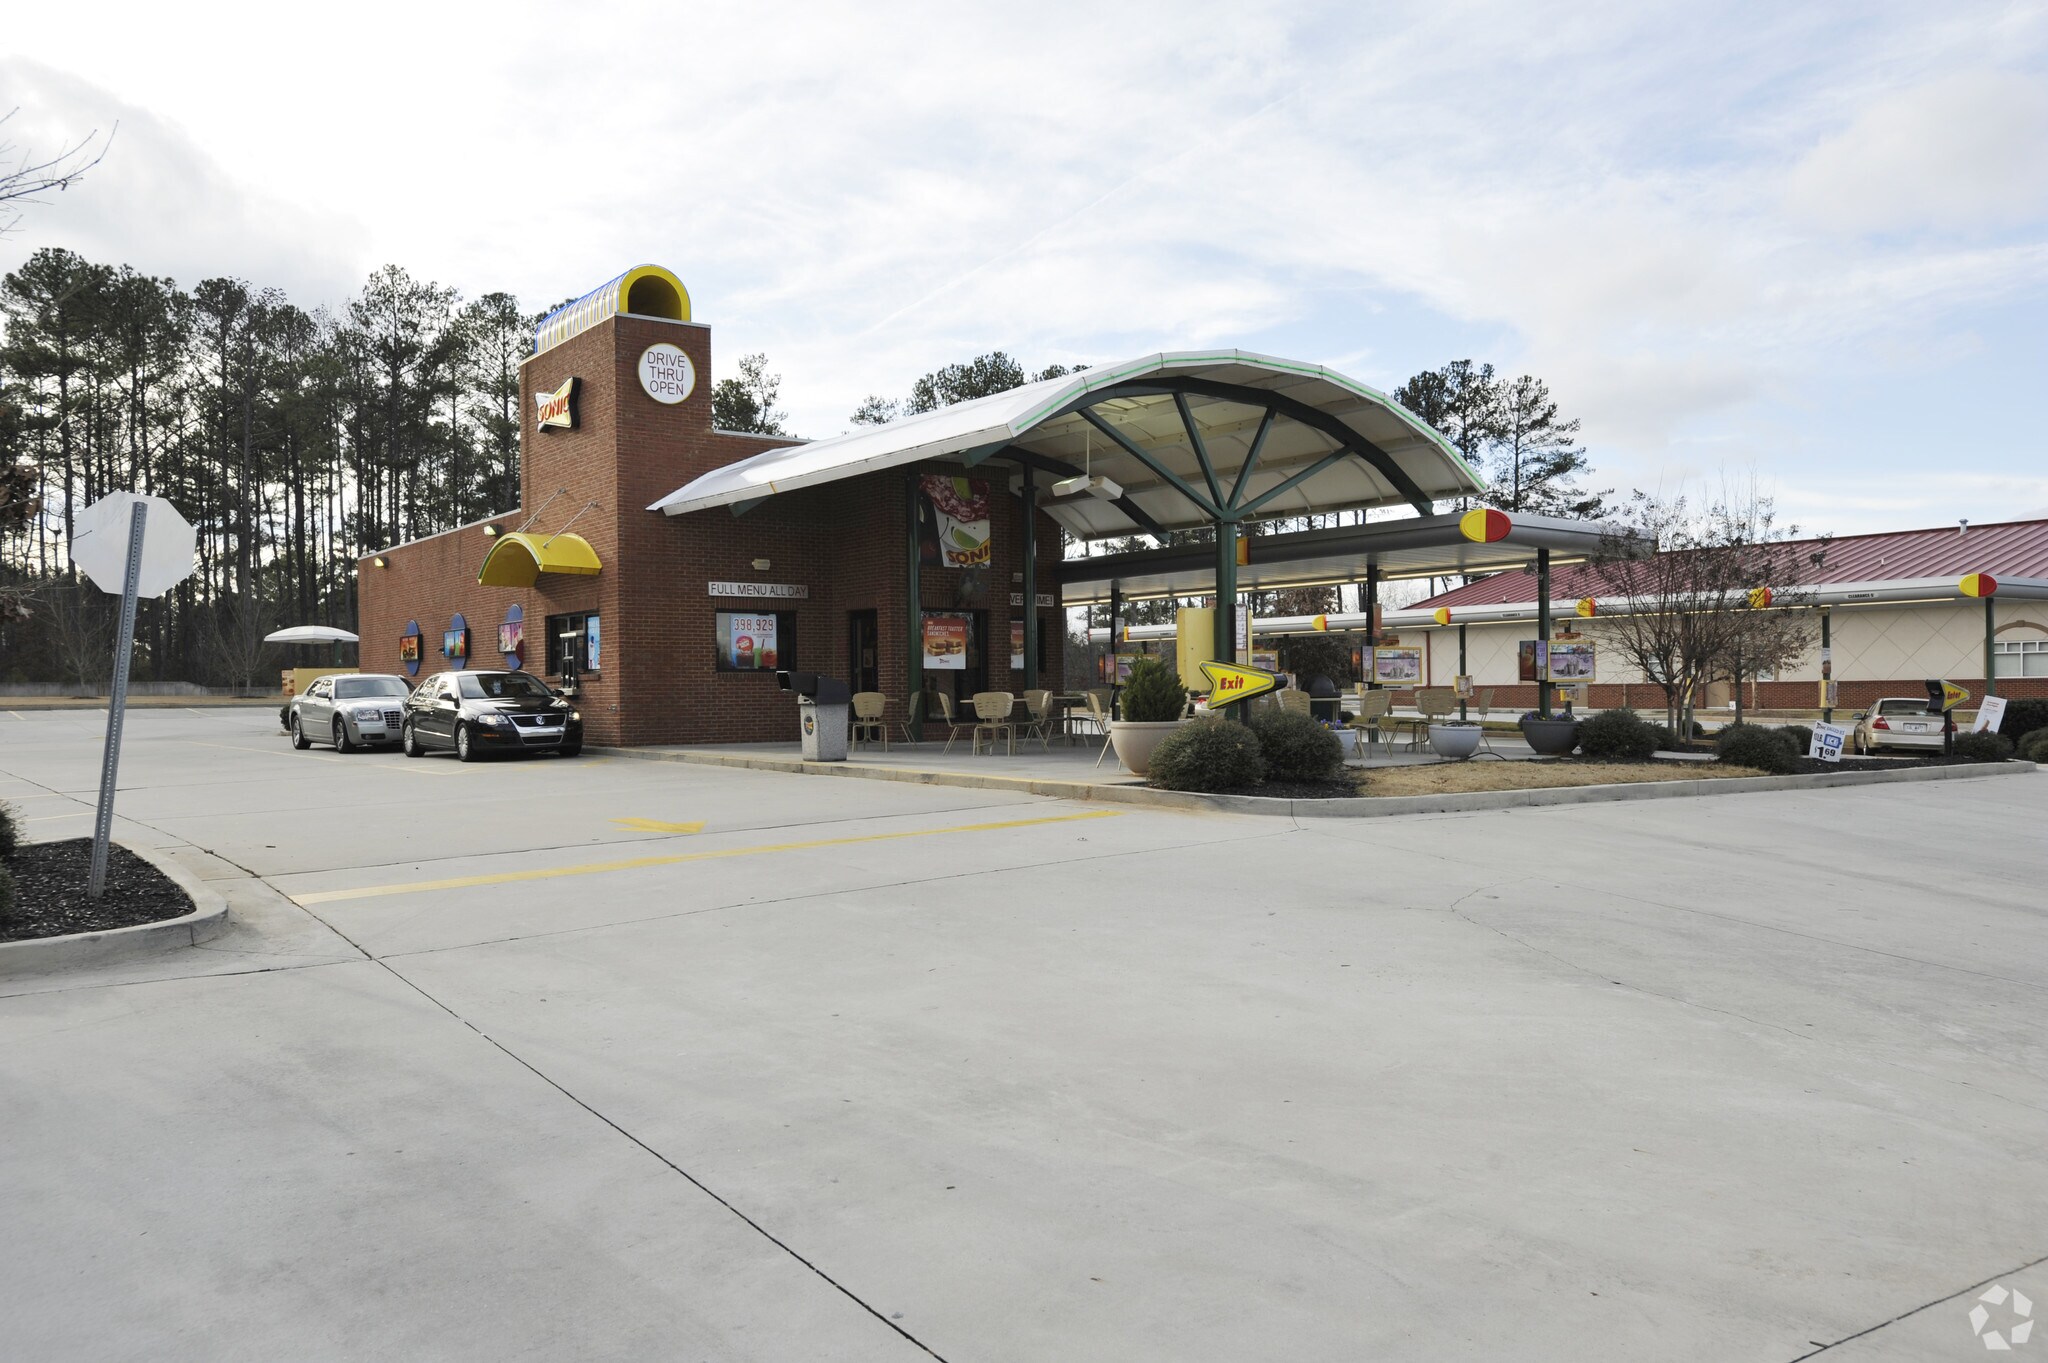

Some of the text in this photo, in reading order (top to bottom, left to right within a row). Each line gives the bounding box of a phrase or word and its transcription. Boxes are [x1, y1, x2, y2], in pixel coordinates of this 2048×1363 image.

[647, 351, 685, 368] DRIVE
[649, 365, 684, 382] THRU
[649, 380, 684, 396] OPEN
[538, 393, 571, 423] SONIC
[946, 544, 989, 565] SONI
[711, 583, 807, 597] FULL MENU ALL DAY
[1037, 595, 1053, 606] IME!
[734, 618, 774, 632] 398,929
[1220, 674, 1244, 690] Exit
[1947, 690, 1961, 700] Enter
